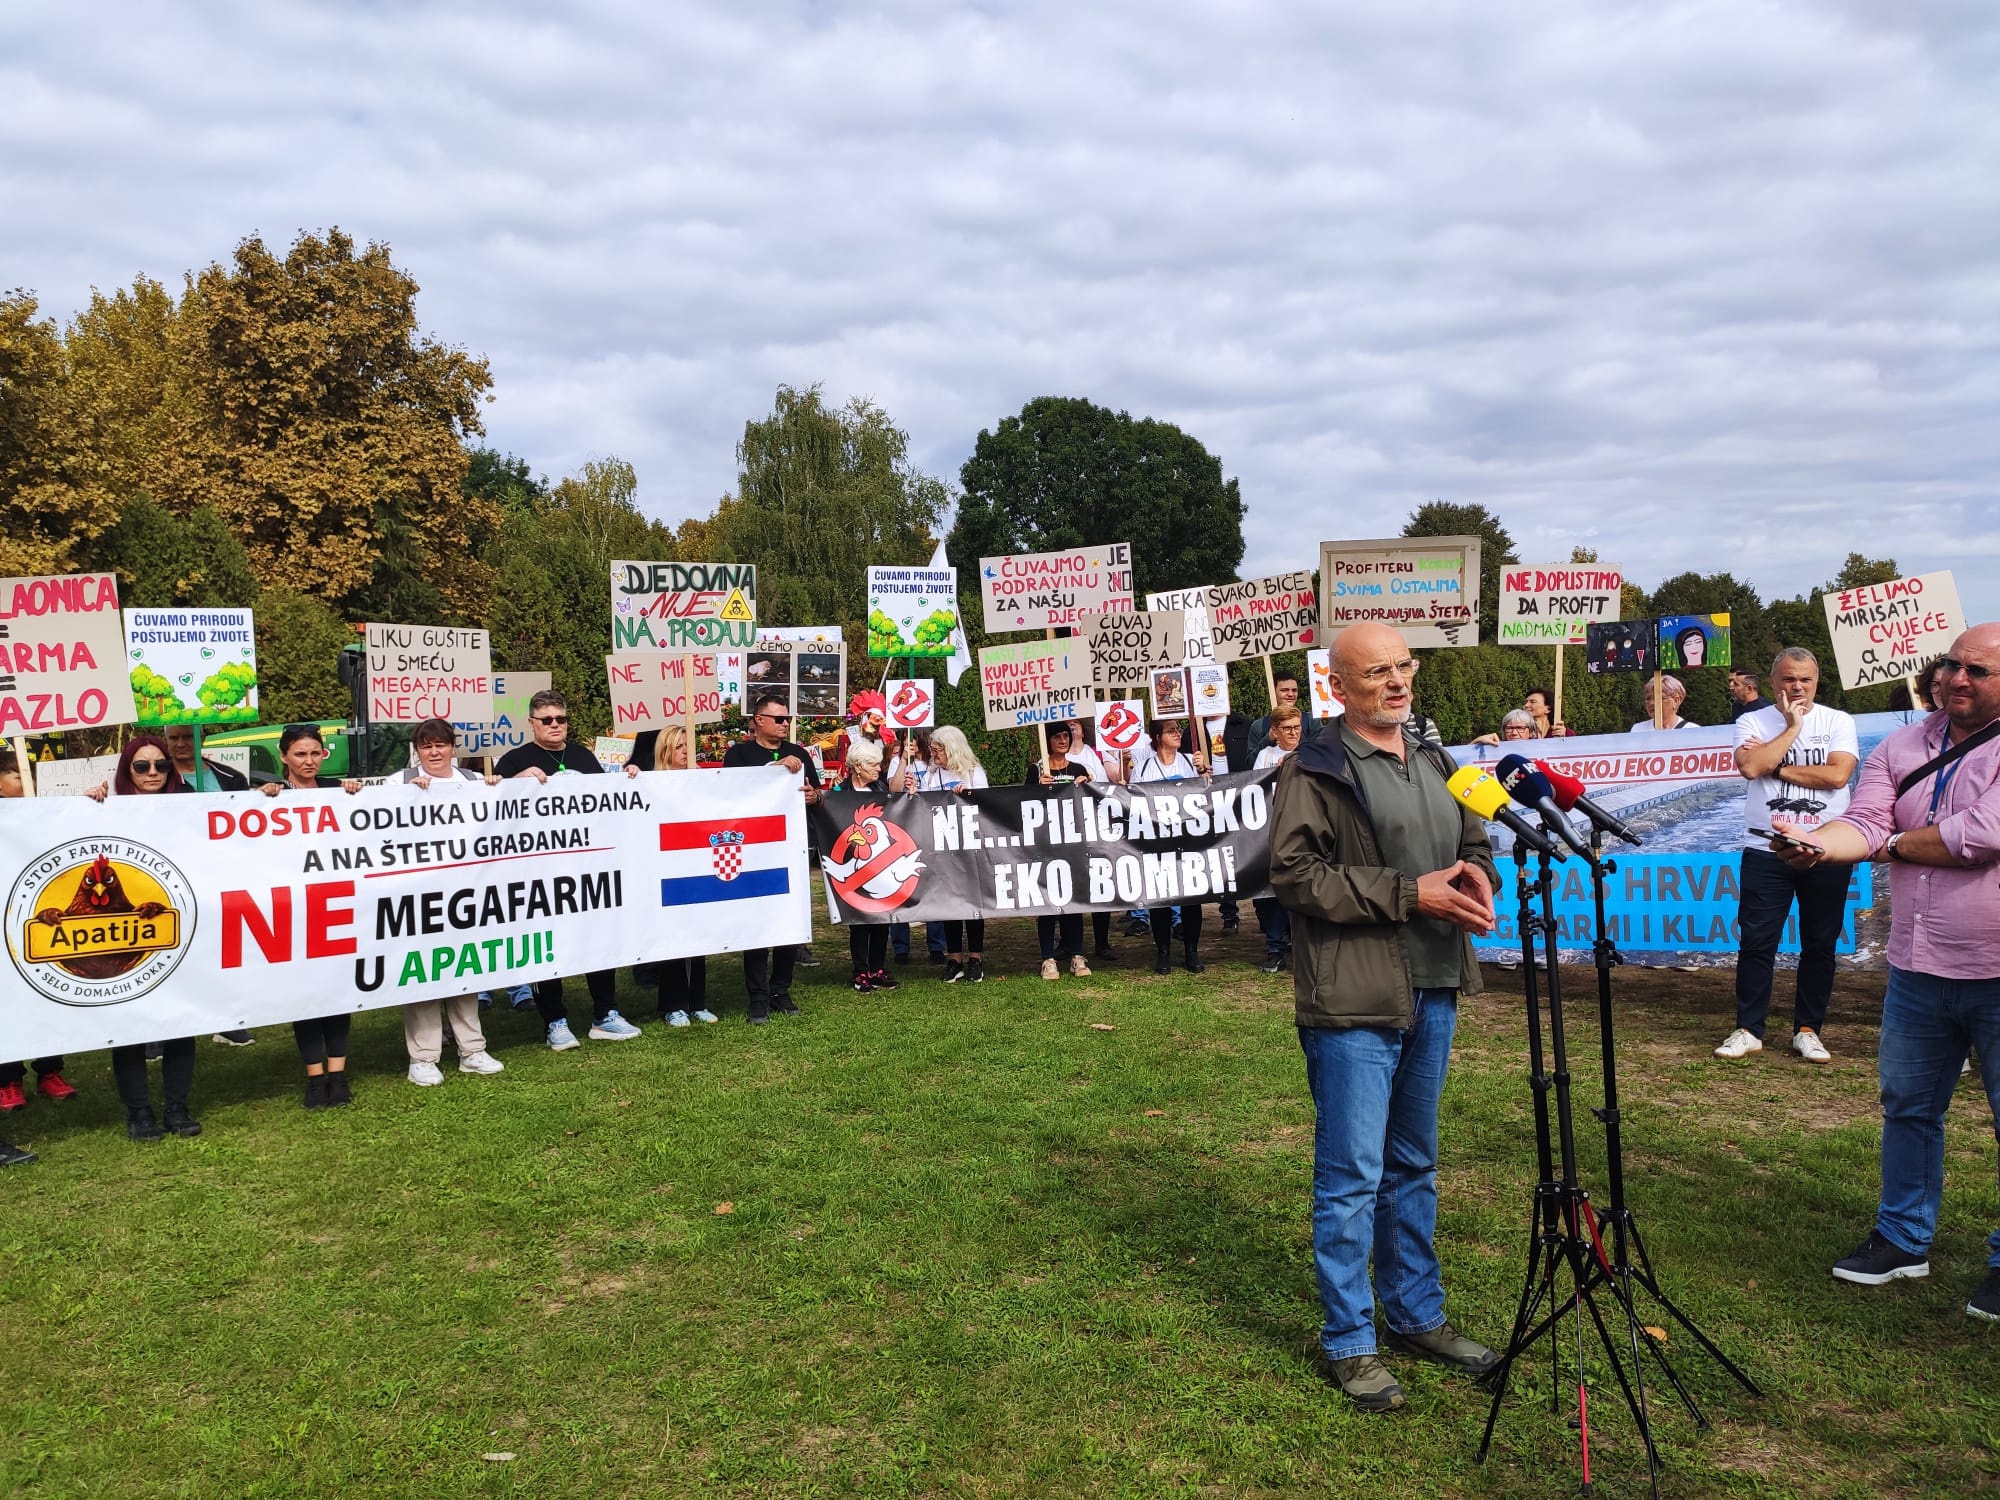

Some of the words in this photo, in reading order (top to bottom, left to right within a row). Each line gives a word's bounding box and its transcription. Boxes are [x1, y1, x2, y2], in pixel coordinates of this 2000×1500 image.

[875, 570, 911, 581] ČUVAMO
[913, 571, 950, 581] PRIRODU
[1001, 555, 1085, 577] ČUVAJMO
[619, 564, 755, 600] DJEDOVINA
[872, 583, 923, 593] POŠTUJEMO
[925, 582, 953, 593] ŽIVOTE
[992, 573, 1098, 596] PODRAVINU
[1209, 582, 1257, 607] SVAKO
[1263, 573, 1307, 595] BIĆE
[1506, 572, 1531, 592] NE
[1534, 571, 1621, 592] DOPUSTIMO
[1838, 577, 1923, 611] ŽELIMO
[647, 591, 726, 618] NIJE
[996, 598, 1020, 612] ZA
[1029, 590, 1075, 609] NAŠU
[1216, 604, 1244, 625] IMA
[1250, 595, 1292, 614] PRAVO
[1297, 590, 1315, 606] NA
[1517, 597, 1539, 615] DA
[1549, 596, 1609, 615] PROFIT
[134, 612, 187, 626] ČUVAMO
[191, 614, 244, 626] PRIRODU
[1212, 608, 1318, 645] DOSTOJANSTVEN
[1503, 618, 1566, 638] NADMAŠI
[1834, 599, 1919, 632] MIRISATI
[1869, 611, 1948, 643] CVIJEĆE
[131, 628, 206, 643] POŠTUJEMO
[210, 628, 250, 643] ŽIVOTE
[423, 629, 481, 649] GUŠITE
[615, 615, 657, 648] NA
[668, 618, 756, 647] PRODAJU
[1239, 630, 1298, 657] ŽIVOT
[1159, 650, 1169, 661] A
[1891, 638, 1918, 657] NE
[371, 655, 386, 672] U
[397, 652, 455, 672] SMEĆU
[612, 664, 642, 683] NE
[661, 654, 714, 680] MIŠE
[984, 657, 1055, 681] KUPUJETE
[372, 677, 487, 694] MEGAFARME
[985, 675, 1051, 696] TRUJETE
[988, 692, 1041, 712] PRLJAVI
[1047, 685, 1092, 704] PROFIT
[374, 693, 450, 720] NEĆU
[617, 701, 651, 723] NA
[1016, 703, 1076, 725] SNUJETE
[1624, 758, 1665, 777] EKO
[1669, 751, 1737, 774] BOMB
[207, 805, 340, 840] DOSTA
[349, 804, 465, 830] ODLUKA
[471, 801, 488, 823] U
[495, 796, 530, 821] IME
[534, 790, 651, 817] GRAĐANA,
[303, 849, 324, 873] A
[333, 846, 373, 870] NA
[381, 839, 467, 866] ŠTETU
[473, 827, 591, 856] GRAĐANA!
[24, 855, 62, 889] STOP
[69, 843, 119, 860] FARMI
[126, 847, 172, 880] PILIĆA
[994, 859, 1073, 910] EKO
[1088, 845, 1237, 904] BOMBI!
[220, 880, 357, 969] NE
[375, 869, 623, 940] MEGAFARMI
[50, 920, 156, 951] Apatija
[354, 955, 385, 992] U
[397, 931, 554, 987] APATIJI!
[42, 972, 70, 992] SELO
[74, 981, 132, 997] DOMAĆIH
[136, 961, 166, 986] KOKA
